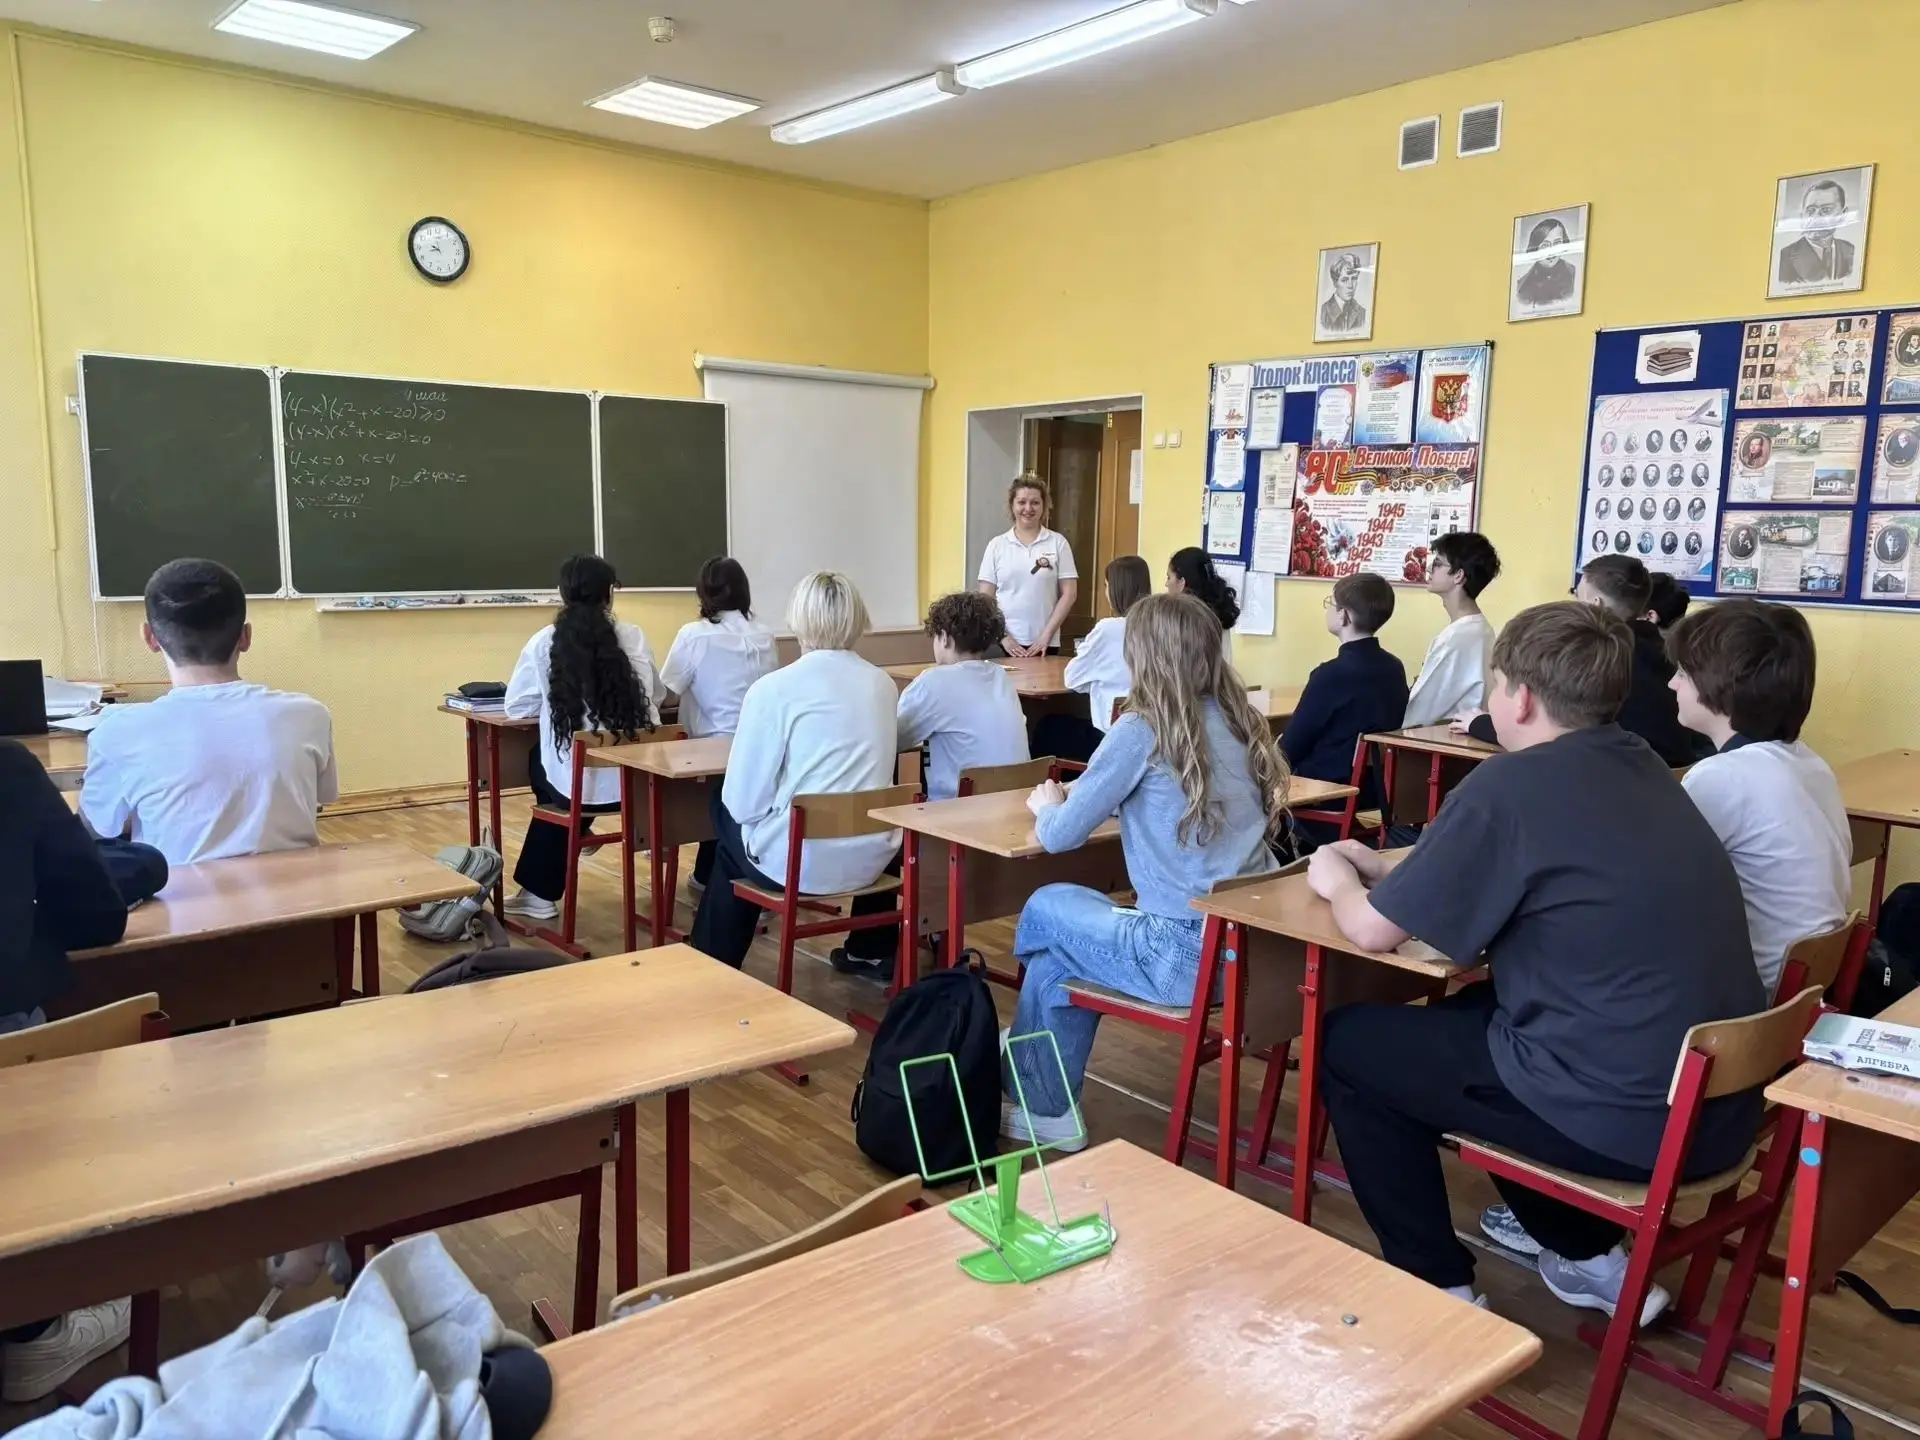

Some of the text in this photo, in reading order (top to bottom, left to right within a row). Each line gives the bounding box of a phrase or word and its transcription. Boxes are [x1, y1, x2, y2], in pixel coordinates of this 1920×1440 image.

[1252, 365, 1302, 386] Уголок
[1303, 449, 1350, 495] 80
[1377, 502, 1407, 518] 1945
[1367, 518, 1395, 533] 1944
[1356, 533, 1385, 547] 1943
[1347, 548, 1373, 562] 1942
[1335, 562, 1361, 577] 1941
[1856, 1055, 1911, 1072] АЛГЕБРА
